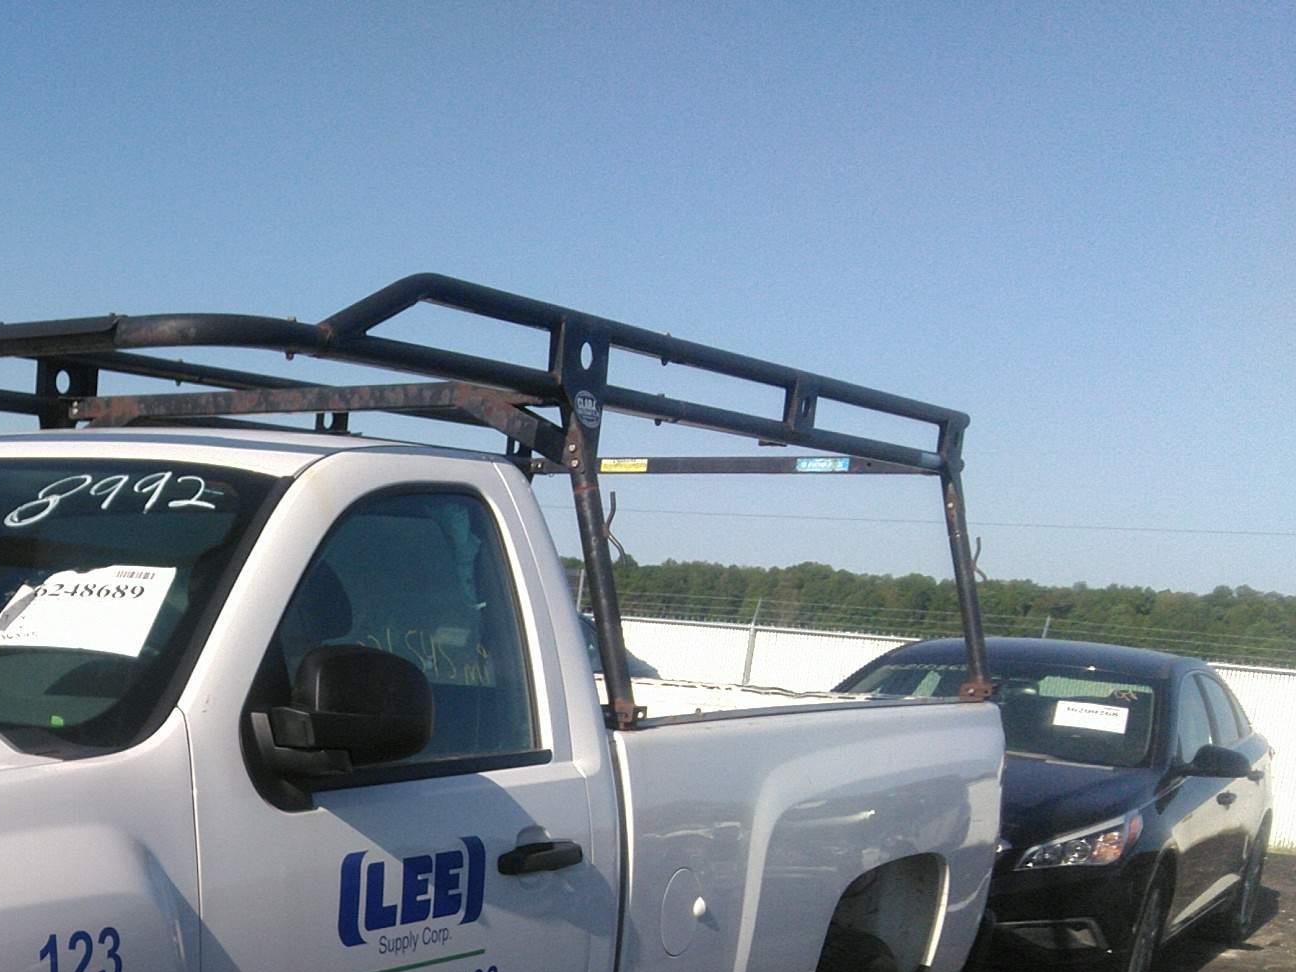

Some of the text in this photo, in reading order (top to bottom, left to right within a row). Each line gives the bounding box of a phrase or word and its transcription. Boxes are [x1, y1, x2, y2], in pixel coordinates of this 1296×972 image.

[3, 471, 217, 528] 8992
[378, 926, 453, 955] Supply Corp.
